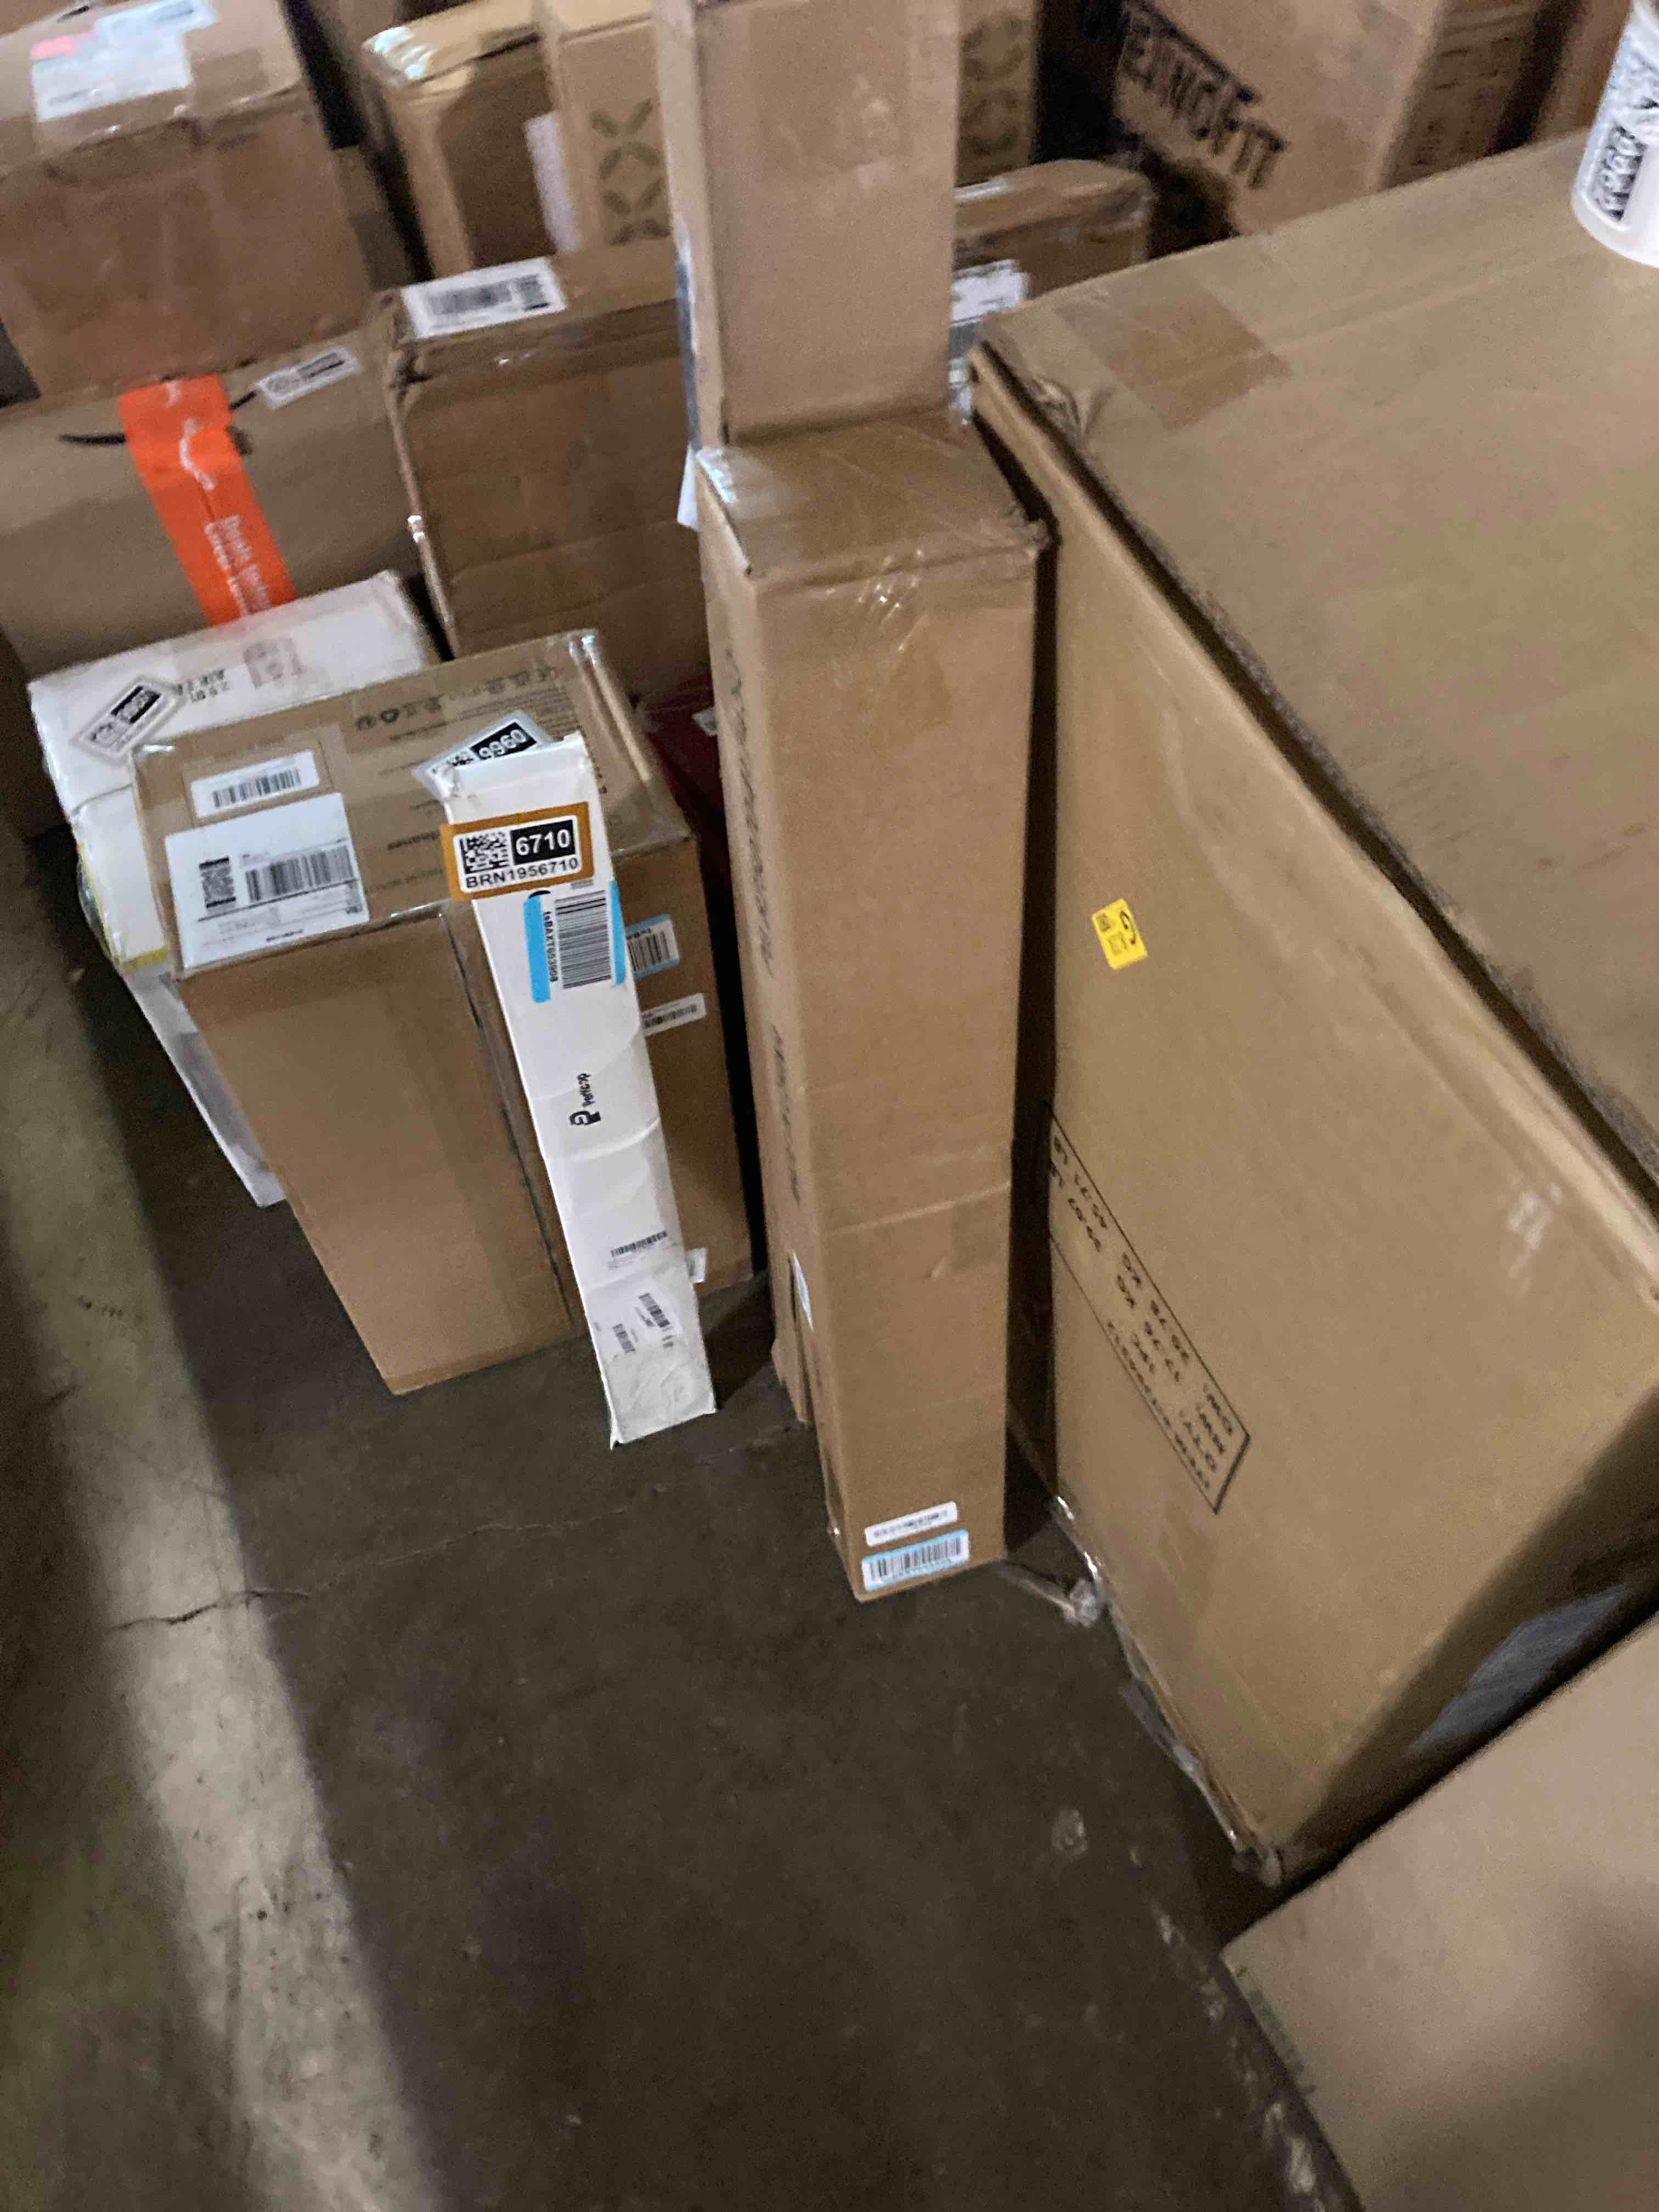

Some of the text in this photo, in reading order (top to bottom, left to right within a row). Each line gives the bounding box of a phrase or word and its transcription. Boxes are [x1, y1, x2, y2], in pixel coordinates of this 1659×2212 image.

[515, 828, 571, 856] 6710
[465, 857, 578, 888] BRN1956710
[1121, 1252, 1142, 1289] KG
[1115, 1273, 1137, 1311] KG
